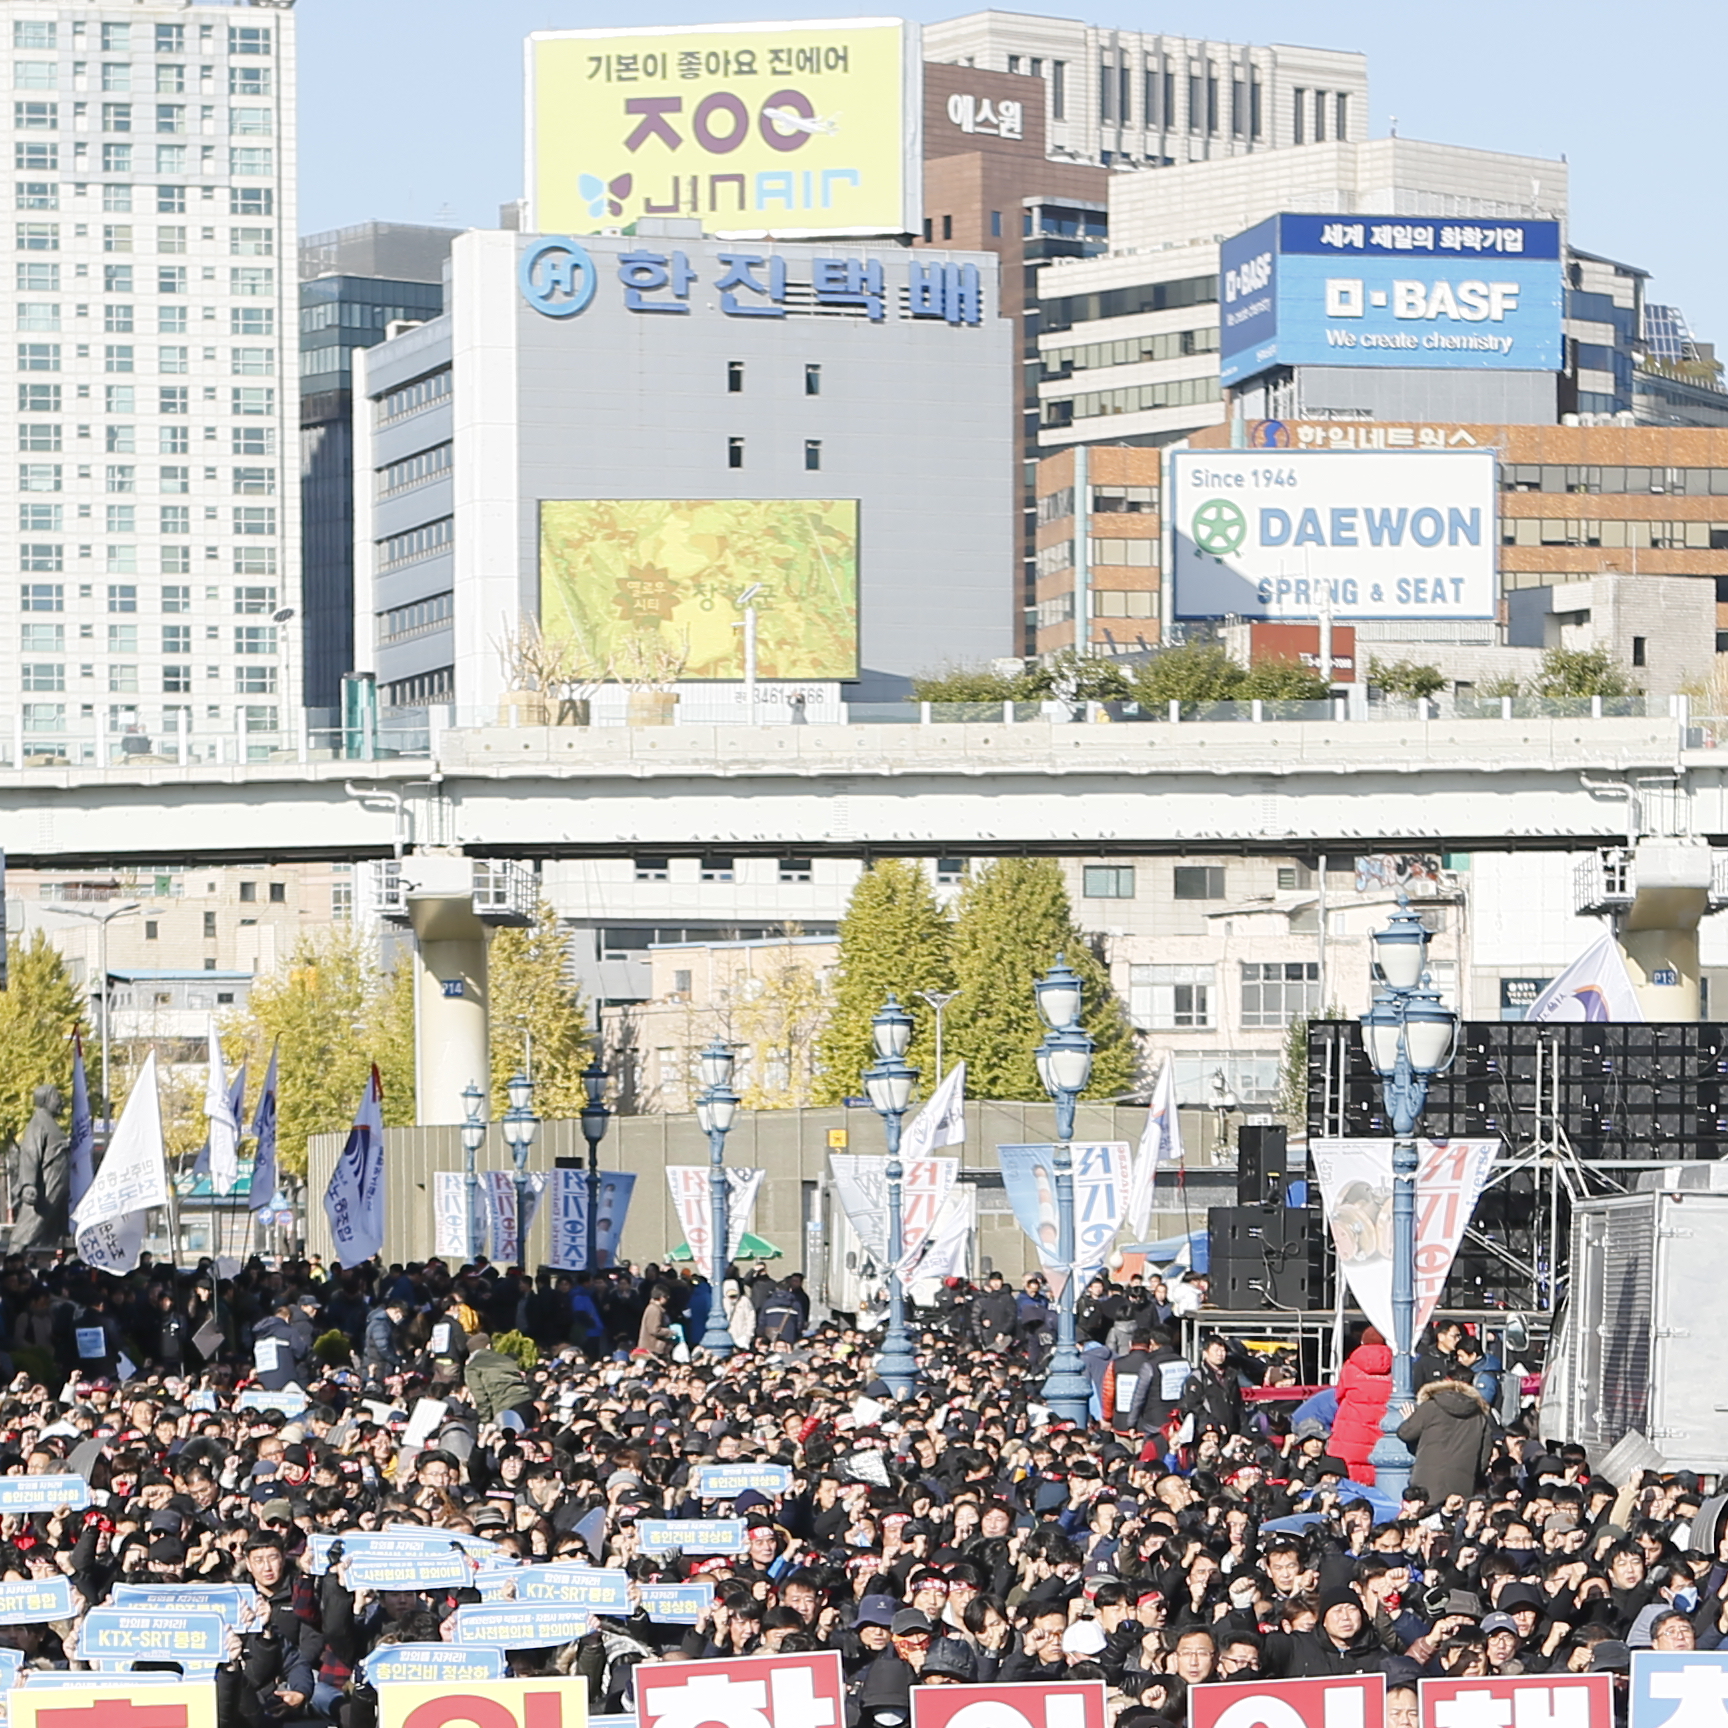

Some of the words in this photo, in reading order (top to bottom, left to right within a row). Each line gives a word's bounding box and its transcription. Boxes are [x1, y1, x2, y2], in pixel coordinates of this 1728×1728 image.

[587, 53, 667, 83] 기본이
[678, 48, 758, 79] 좋아요
[768, 45, 850, 75] 진에어
[946, 92, 1024, 141] 에스원
[1320, 223, 1363, 248] 세계
[1370, 223, 1434, 251] 제일의
[1440, 226, 1524, 253] 화학기업
[616, 248, 984, 325] 한진택배
[1392, 279, 1520, 321] BASF
[1326, 329, 1356, 347] We
[1360, 333, 1418, 351] create
[1422, 332, 1513, 355] chemistry
[1191, 469, 1245, 488] Since
[1251, 468, 1297, 488] 1946
[1258, 507, 1481, 548] DAEWON
[1257, 577, 1359, 605] SPRNG
[1395, 577, 1466, 604] SEAT
